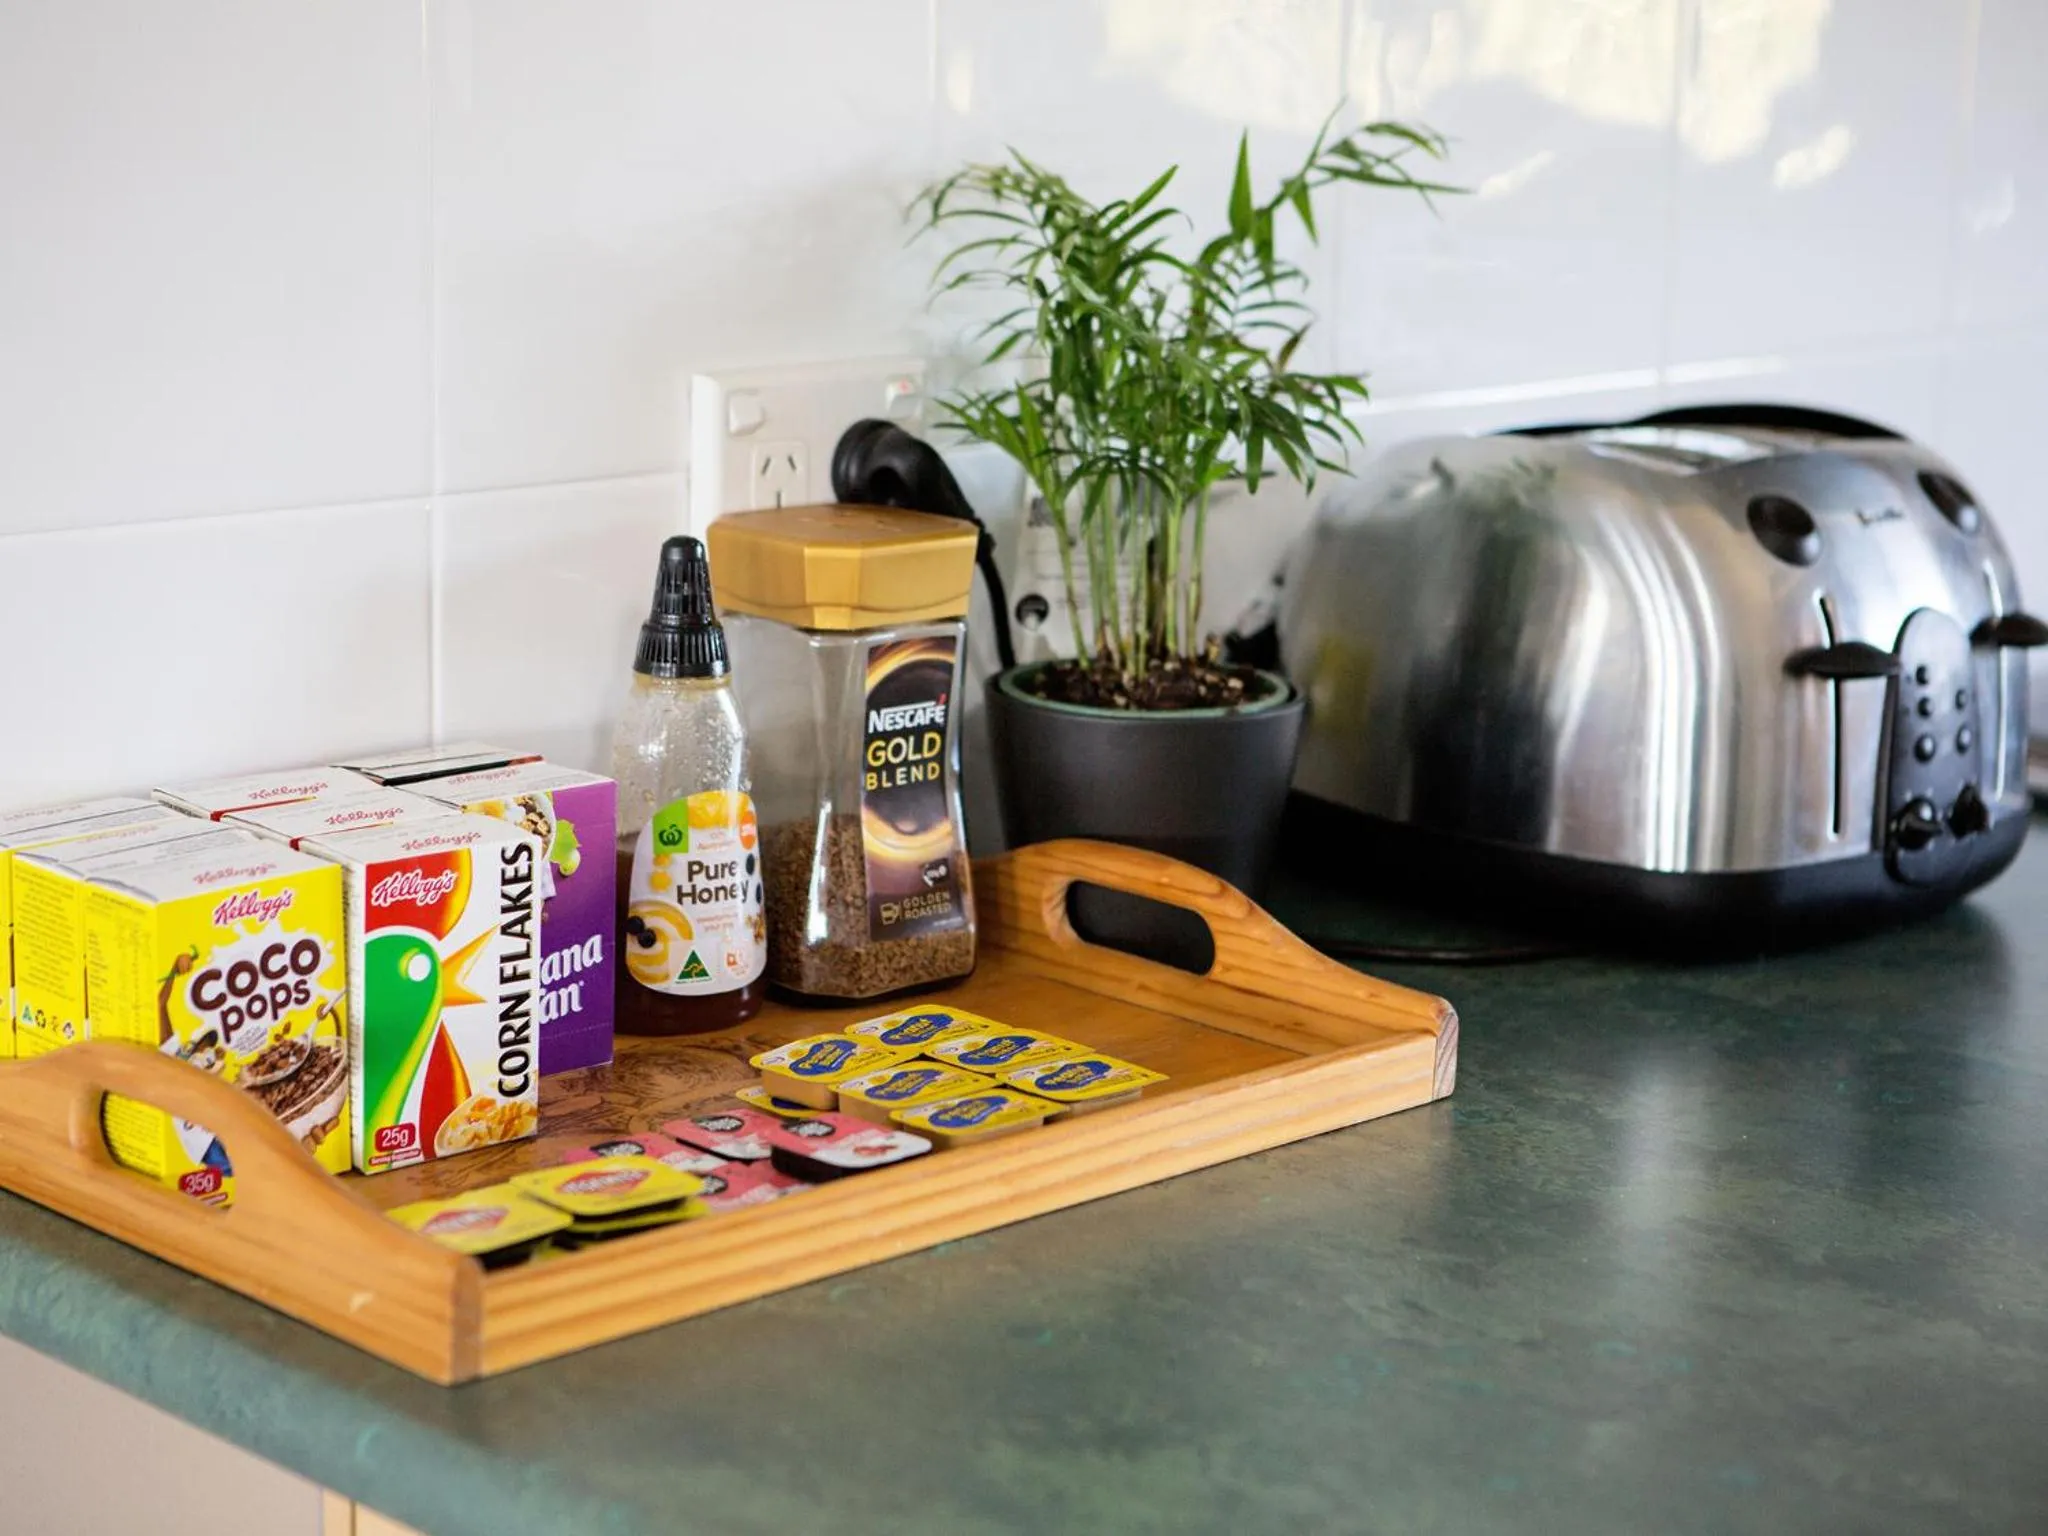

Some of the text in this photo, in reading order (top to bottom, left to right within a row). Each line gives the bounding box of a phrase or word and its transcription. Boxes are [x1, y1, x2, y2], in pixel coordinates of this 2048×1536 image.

[867, 731, 942, 767] GOLD
[865, 761, 940, 791] BLEND
[371, 868, 457, 906] Kellogg's
[687, 859, 738, 883] Pure
[214, 889, 293, 926] Kellogg's
[676, 879, 750, 905] Honey
[498, 841, 534, 1098] CORN FLAKES
[539, 934, 604, 986] ana
[221, 979, 311, 1044] pops
[539, 982, 584, 1025] an
[381, 1126, 410, 1148] 25g
[184, 1172, 215, 1194] 35g
